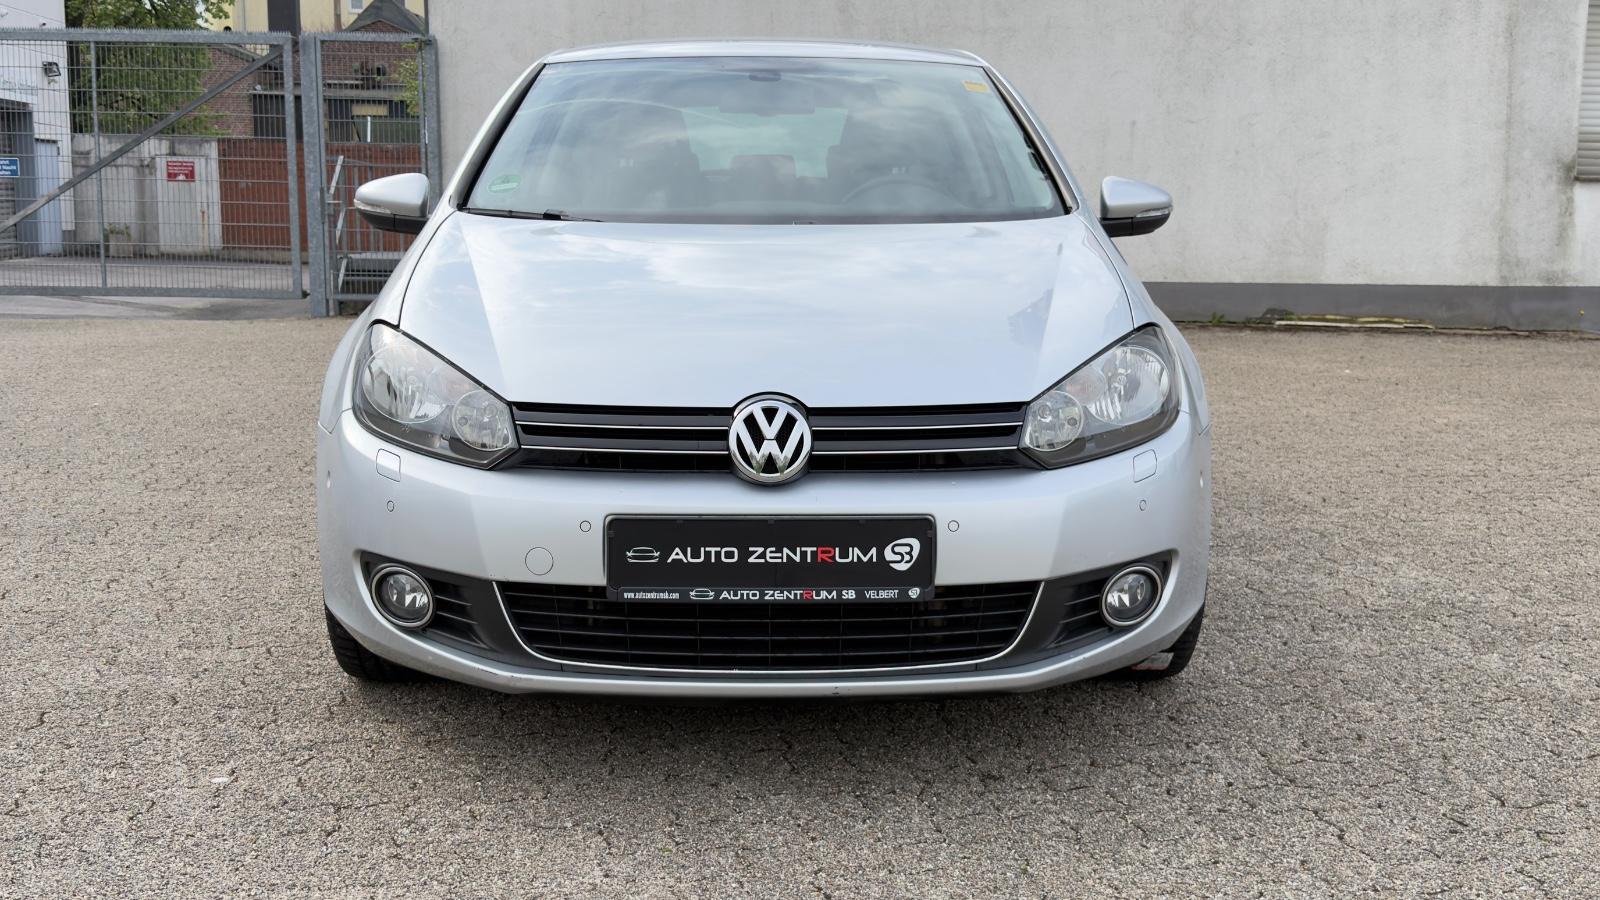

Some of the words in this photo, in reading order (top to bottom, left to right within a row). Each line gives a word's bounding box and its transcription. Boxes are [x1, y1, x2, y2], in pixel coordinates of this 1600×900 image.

[734, 404, 806, 475] VW
[666, 546, 739, 563] AUTO
[747, 546, 877, 563] ZENTRUM
[719, 590, 760, 600] AUTO
[764, 590, 837, 600] ZENTRUM
[841, 589, 857, 599] SB
[864, 589, 899, 599] VELBERT
